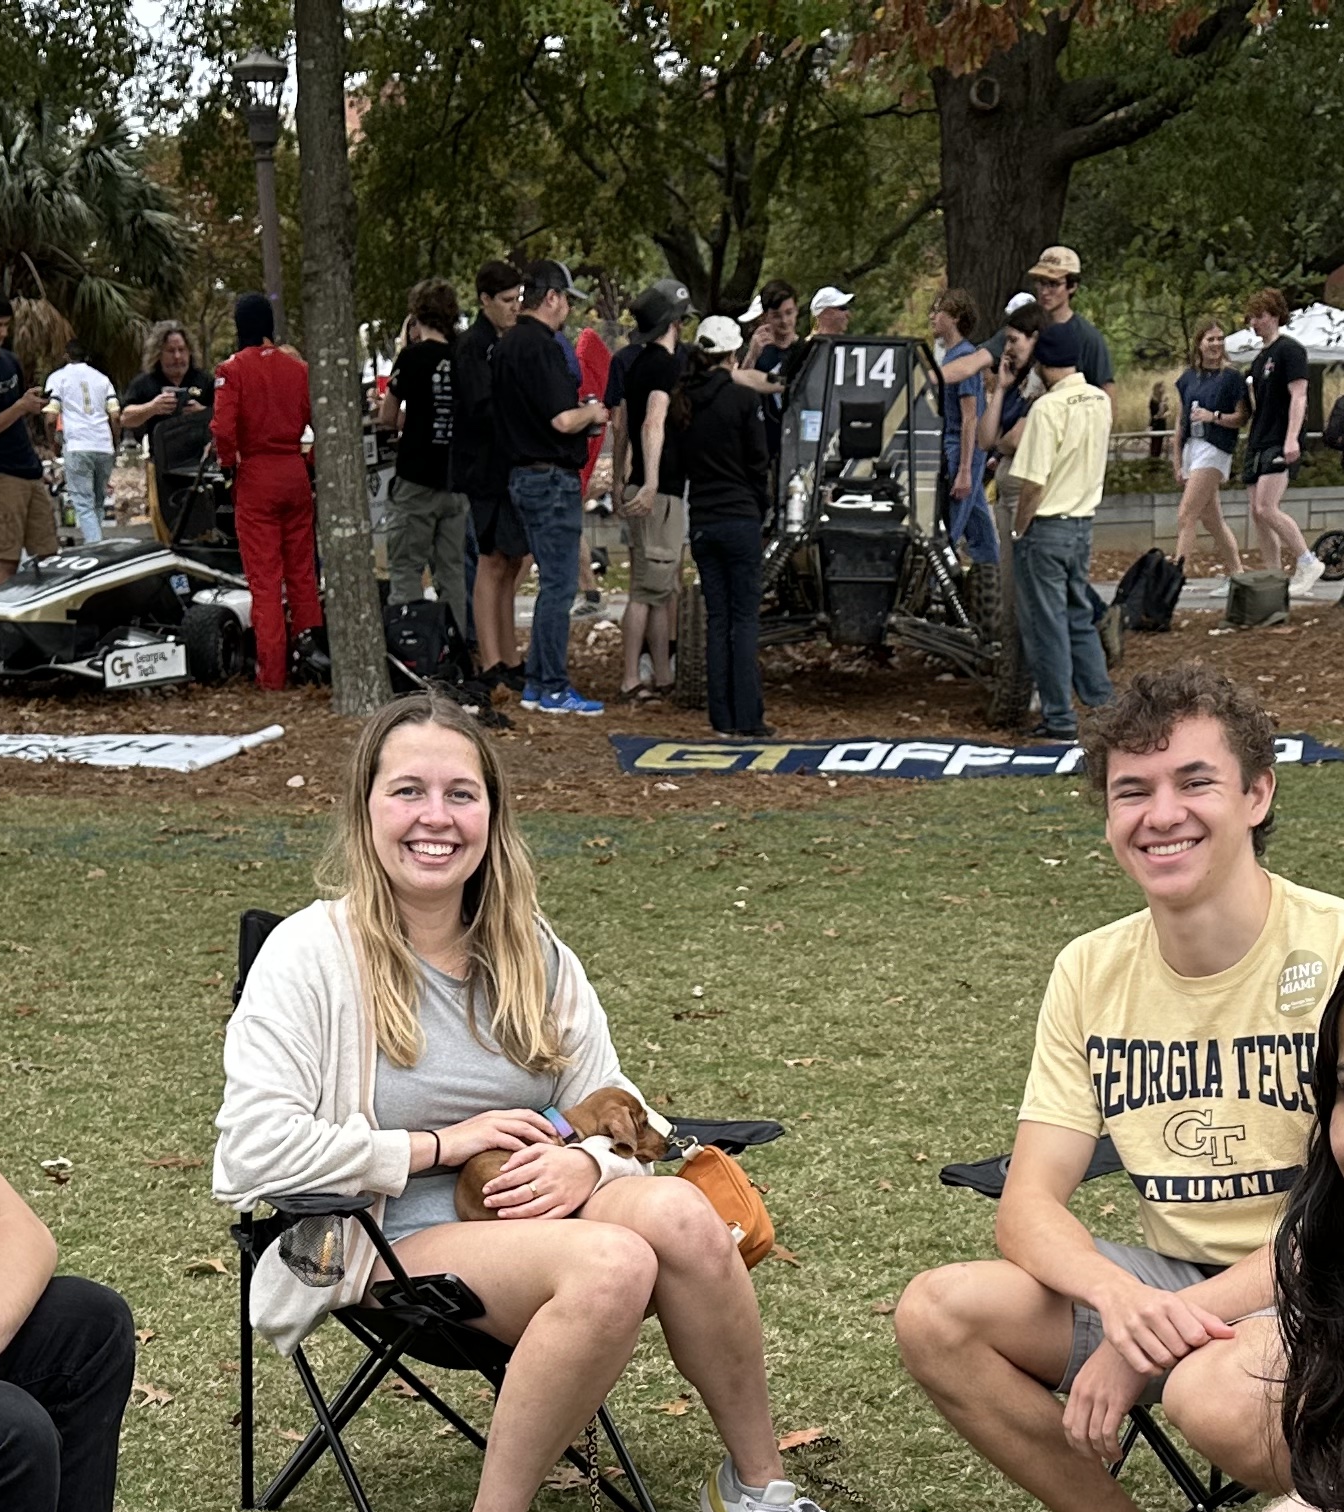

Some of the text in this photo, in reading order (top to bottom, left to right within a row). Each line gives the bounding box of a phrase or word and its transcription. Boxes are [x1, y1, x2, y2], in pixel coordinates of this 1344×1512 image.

[834, 346, 896, 389] 114
[634, 741, 834, 772] GT
[1278, 961, 1323, 985] STING
[1280, 977, 1316, 996] MIAMI
[1086, 1032, 1316, 1120] GEORGIA TECH
[1163, 1109, 1246, 1167] GT
[1144, 1173, 1275, 1201] ALUMNI
